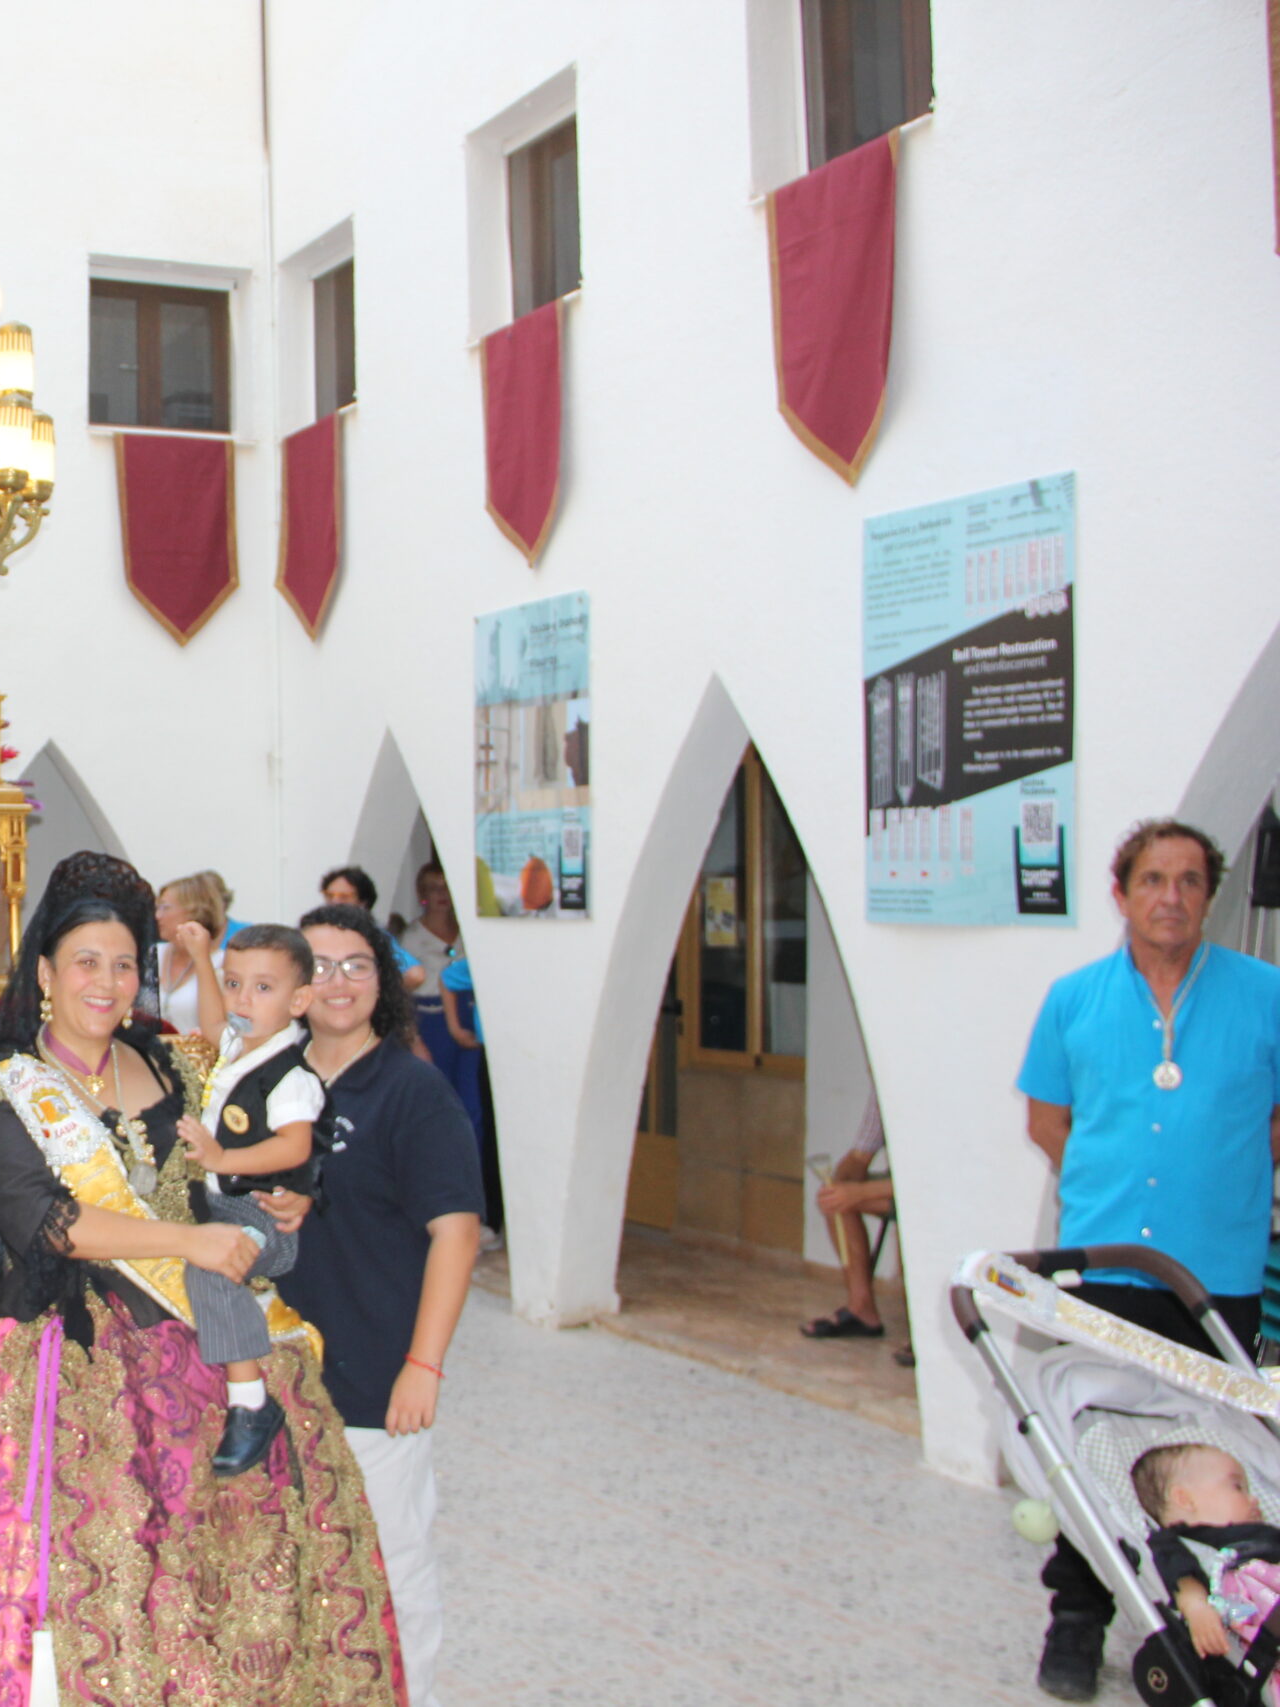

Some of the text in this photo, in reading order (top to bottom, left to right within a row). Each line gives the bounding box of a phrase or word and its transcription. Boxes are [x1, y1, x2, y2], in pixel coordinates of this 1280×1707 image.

[952, 638, 1057, 662] Bell Tower Restoration
[964, 663, 980, 676] and
